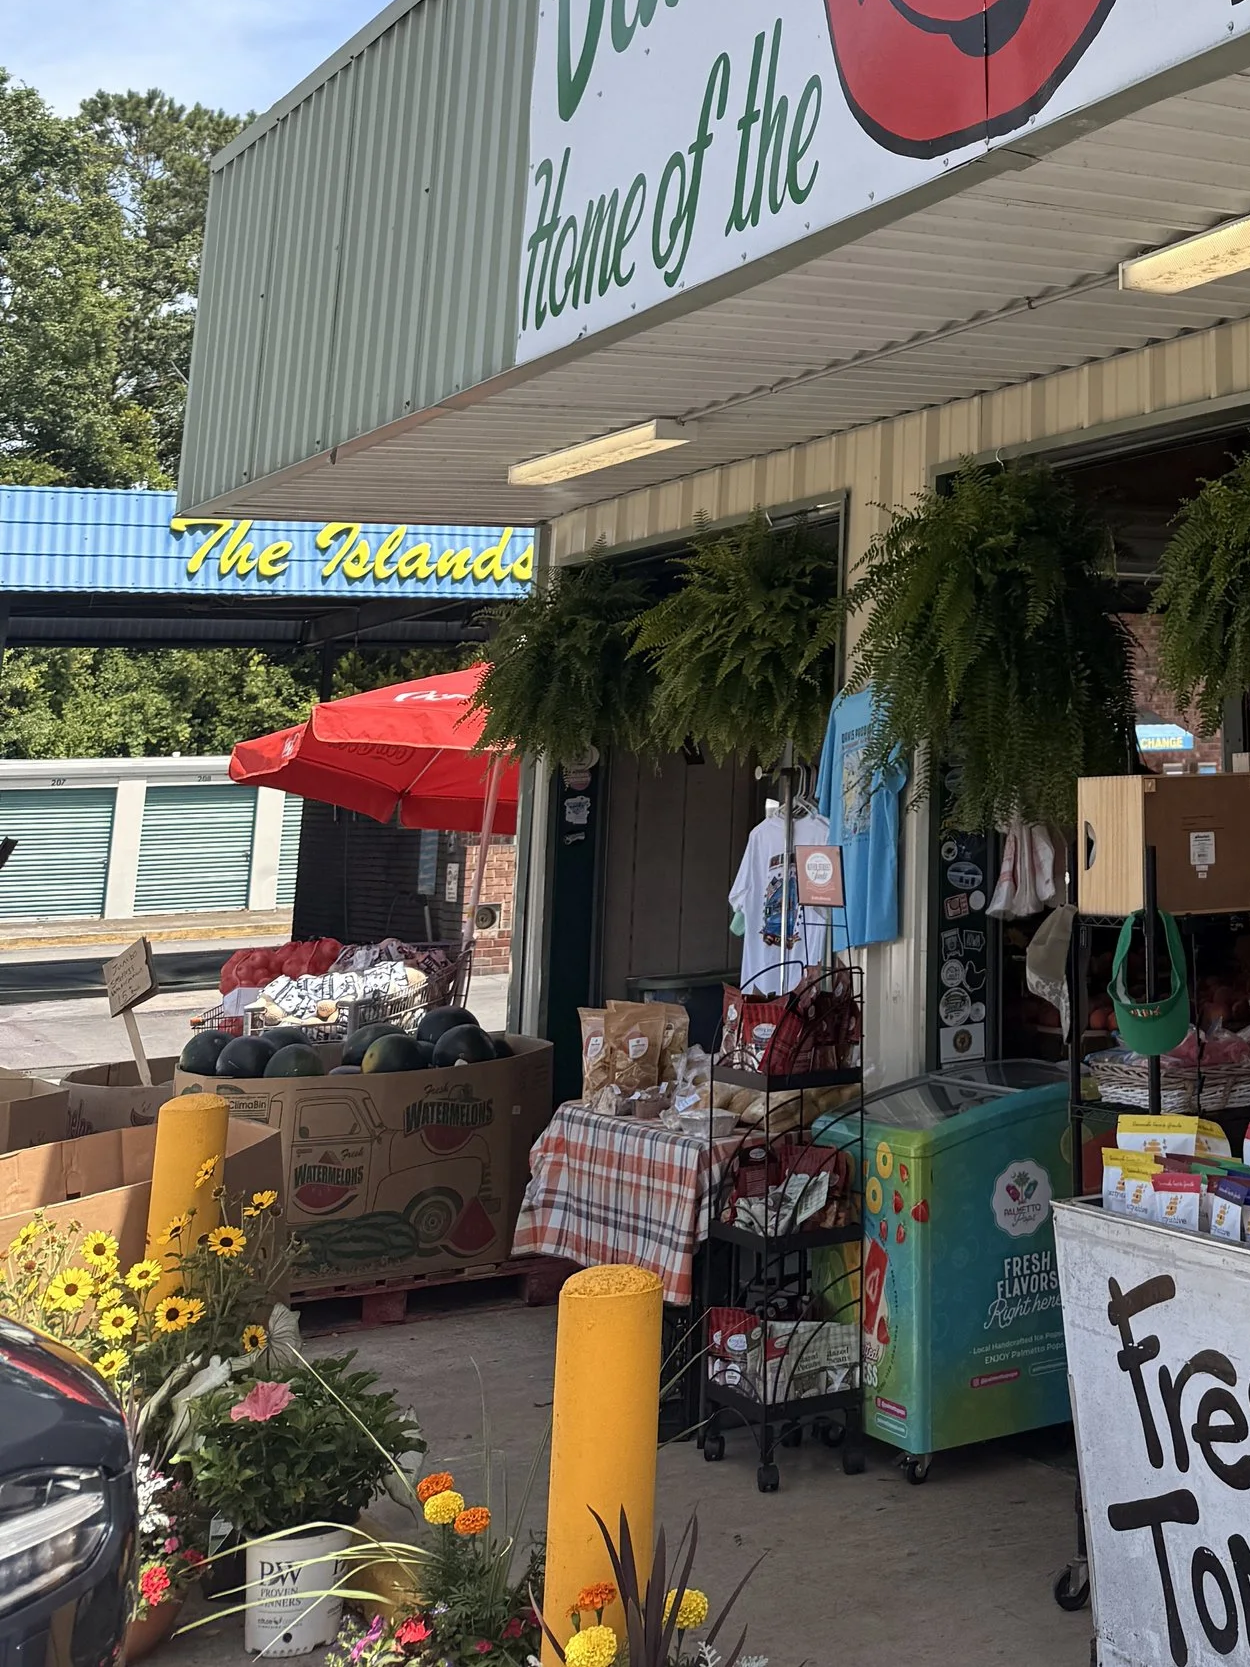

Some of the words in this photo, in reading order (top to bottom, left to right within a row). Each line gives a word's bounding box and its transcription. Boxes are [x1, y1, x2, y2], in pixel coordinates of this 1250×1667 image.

[521, 147, 648, 331] Home
[652, 51, 730, 288] of
[724, 19, 823, 238] the
[171, 518, 293, 577] The
[316, 522, 534, 581] Islands
[1141, 737, 1183, 749] CHANGE
[51, 778, 66, 787] 207
[229, 1099, 267, 1110] ClimaBin
[404, 1098, 494, 1136] WATERMELONS
[294, 1162, 364, 1189] WATERMELONS
[1004, 1203, 1041, 1217] PALMETTO
[1004, 1250, 1051, 1278] FRESH
[997, 1270, 1058, 1299] FLAVORS
[983, 1294, 1032, 1330] Right
[973, 1344, 991, 1355] Local
[992, 1335, 1033, 1351] Handcrafted
[985, 1352, 1010, 1364] ENJOY
[1011, 1346, 1046, 1359] Palmetto
[1046, 1342, 1065, 1352] Pops
[260, 1586, 299, 1597] PROVEN
